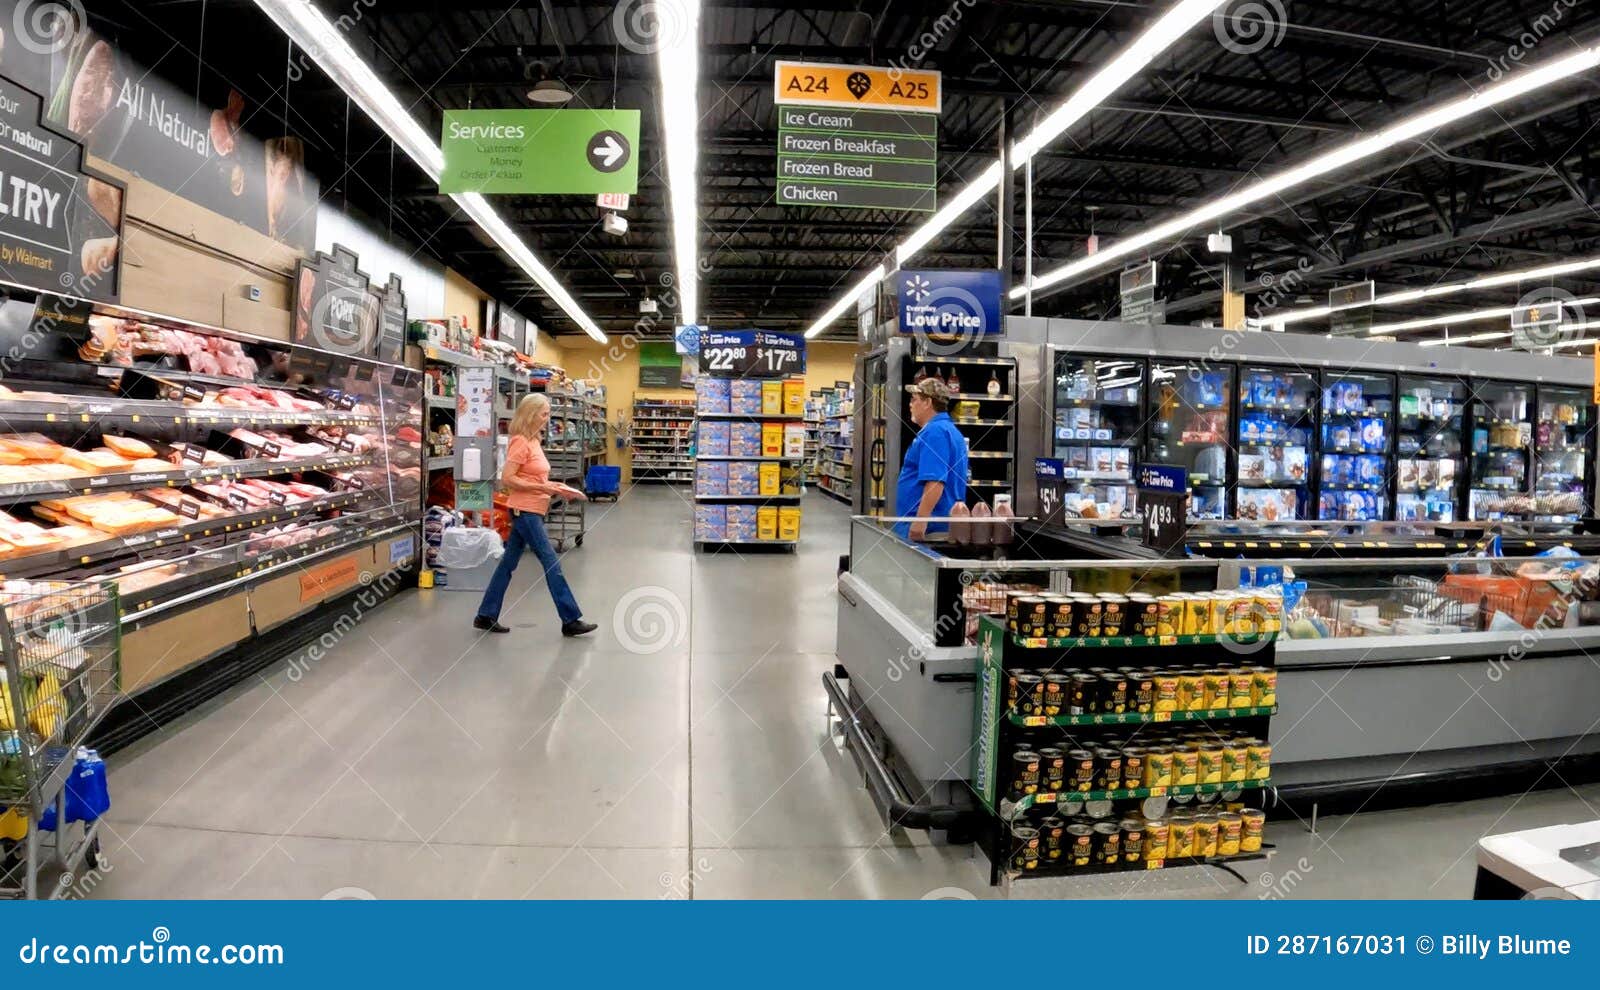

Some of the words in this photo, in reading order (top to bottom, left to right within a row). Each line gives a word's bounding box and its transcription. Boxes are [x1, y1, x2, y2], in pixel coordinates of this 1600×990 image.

[787, 75, 829, 93] A24
[889, 81, 929, 100] A25
[116, 77, 145, 121] All
[148, 93, 210, 158] Natural
[785, 112, 805, 126] Ice
[808, 113, 853, 128] Cream
[449, 122, 525, 140] Services
[12, 129, 52, 157] natural
[784, 136, 830, 152] Frozen
[834, 138, 896, 155] Breakfast
[490, 157, 523, 168] Money
[784, 160, 830, 175] Frozen
[833, 162, 873, 177] Bread
[783, 185, 838, 201] Chicken
[2, 245, 17, 264] by
[16, 248, 53, 271] Walmart
[331, 295, 354, 323] PORK
[906, 312, 939, 327] Low
[941, 312, 981, 327] Price
[1149, 475, 1161, 486] Low
[1160, 475, 1175, 488] Price
